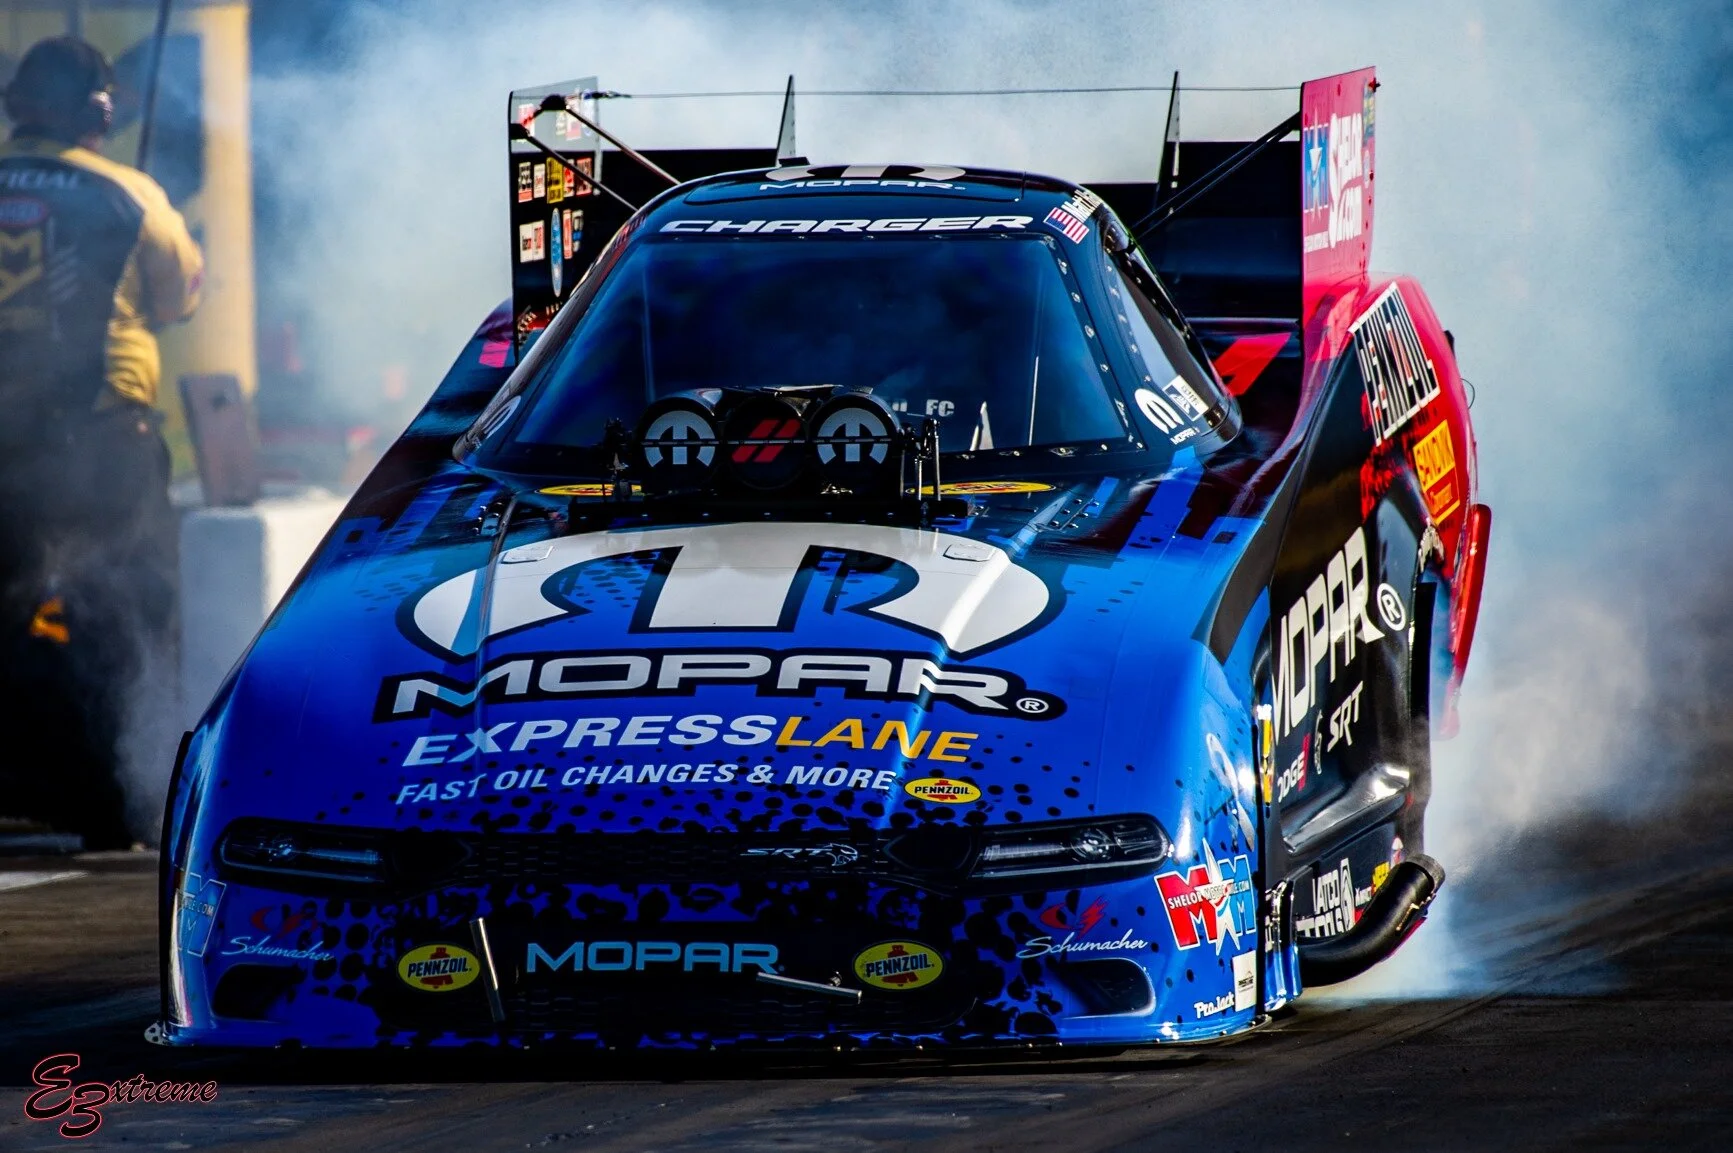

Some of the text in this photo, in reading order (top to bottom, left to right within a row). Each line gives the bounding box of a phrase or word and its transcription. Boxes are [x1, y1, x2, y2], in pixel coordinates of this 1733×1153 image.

[759, 179, 954, 190] MOPAR
[658, 214, 1034, 233] CHARGER
[1348, 281, 1441, 448] PENNZOIL
[926, 399, 955, 417] FC
[1270, 526, 1385, 745] MOPAR
[391, 653, 1011, 714] MOPAR
[1327, 680, 1364, 753] SRT
[396, 763, 897, 805] FAST OIL CHANGES & MORE
[914, 785, 974, 795] PENNZOIL
[740, 847, 833, 859] SRT
[221, 935, 335, 961] Schumacher
[1016, 928, 1149, 959] Schumacher
[407, 956, 473, 979] PENNZOIL
[526, 940, 780, 975] MOPAR
[864, 951, 935, 978] PENNZOIL
